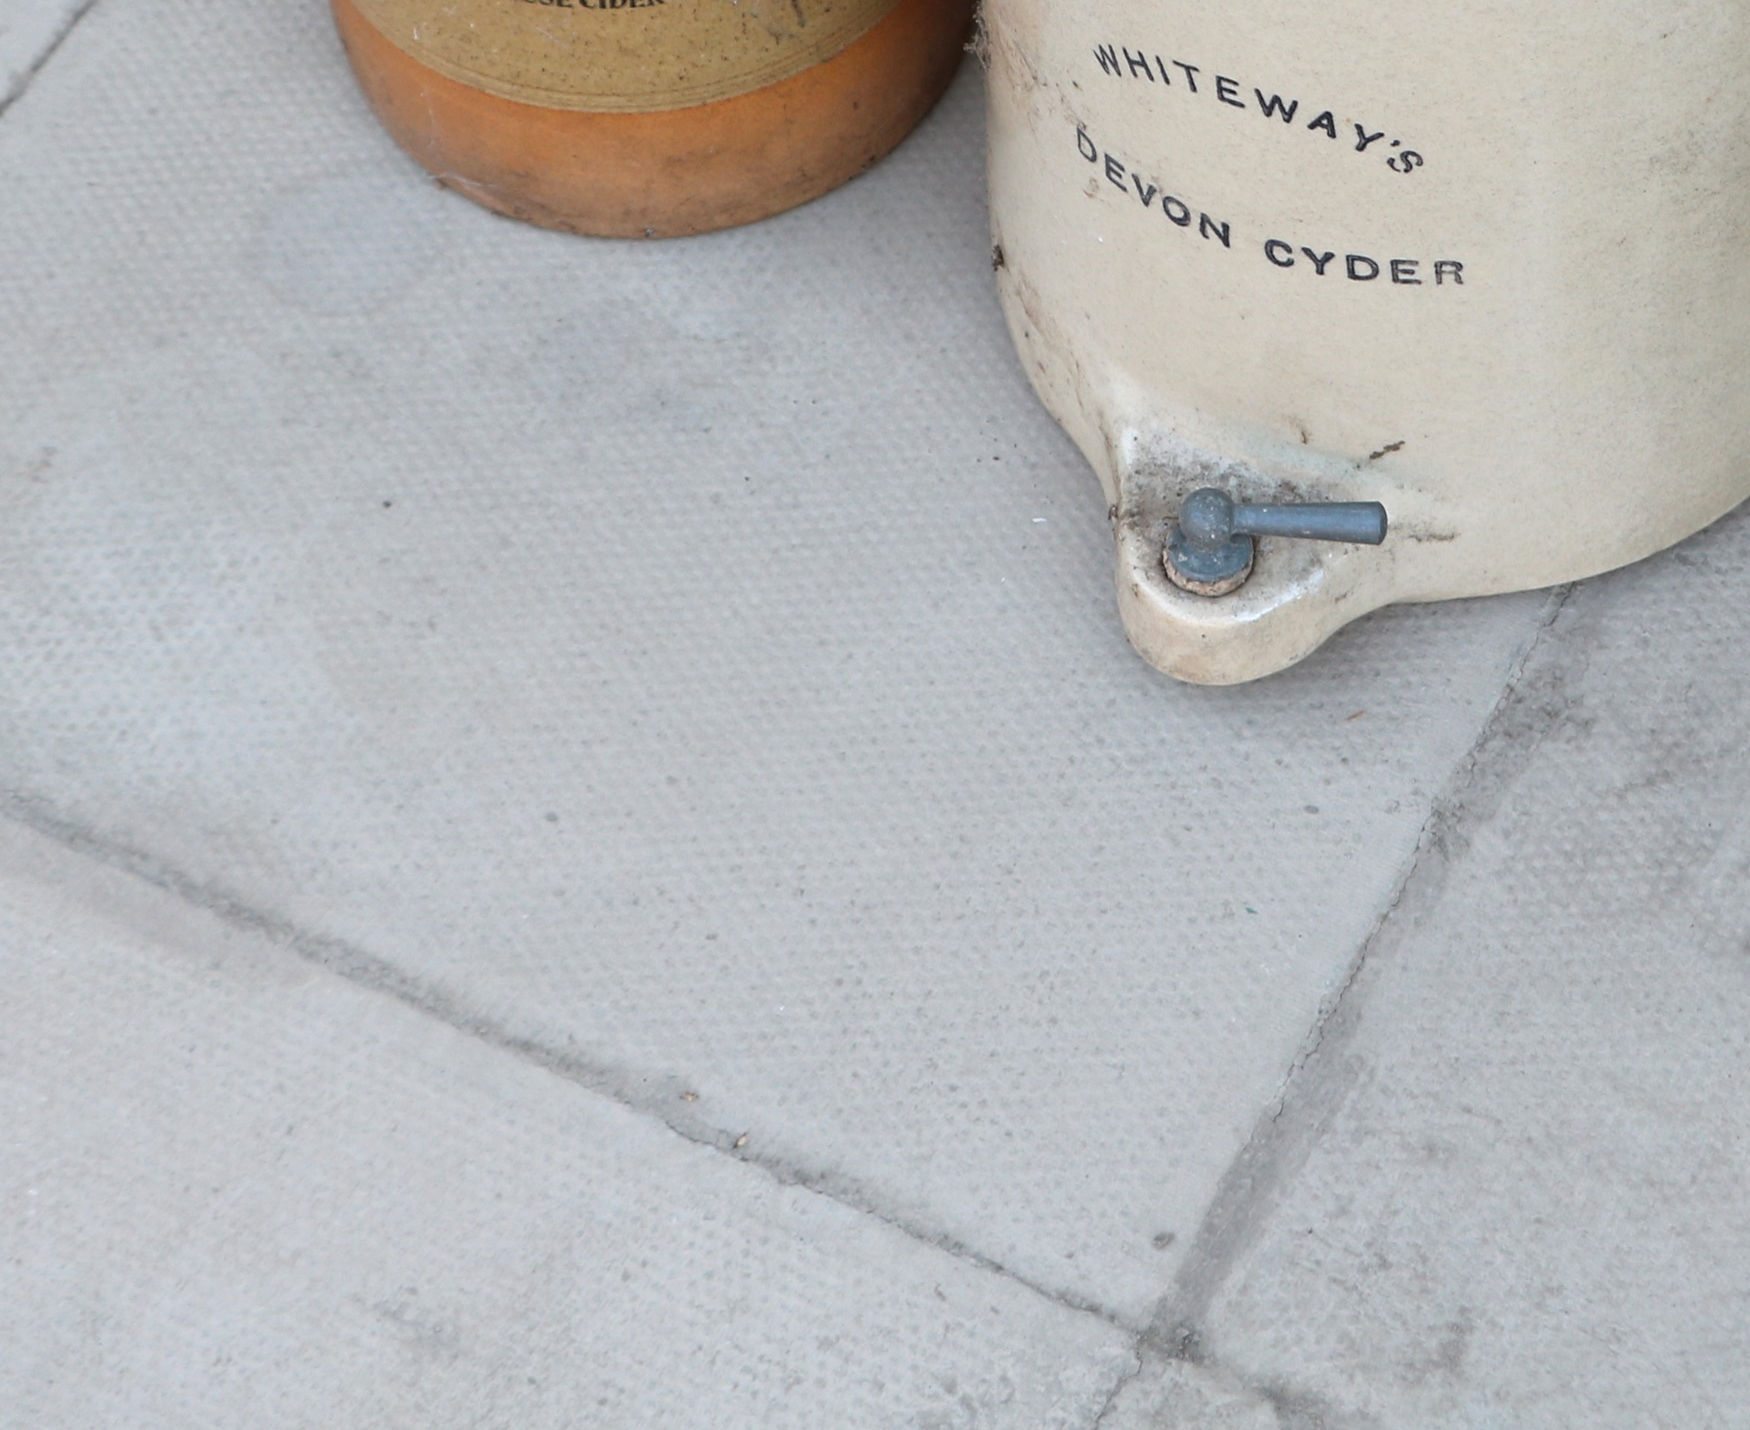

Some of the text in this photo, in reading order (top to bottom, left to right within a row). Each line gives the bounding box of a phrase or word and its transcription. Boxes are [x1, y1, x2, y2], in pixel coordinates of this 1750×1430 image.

[1092, 44, 1424, 174] WHITEWAY'S
[1076, 127, 1465, 287] DEVON CYDER
